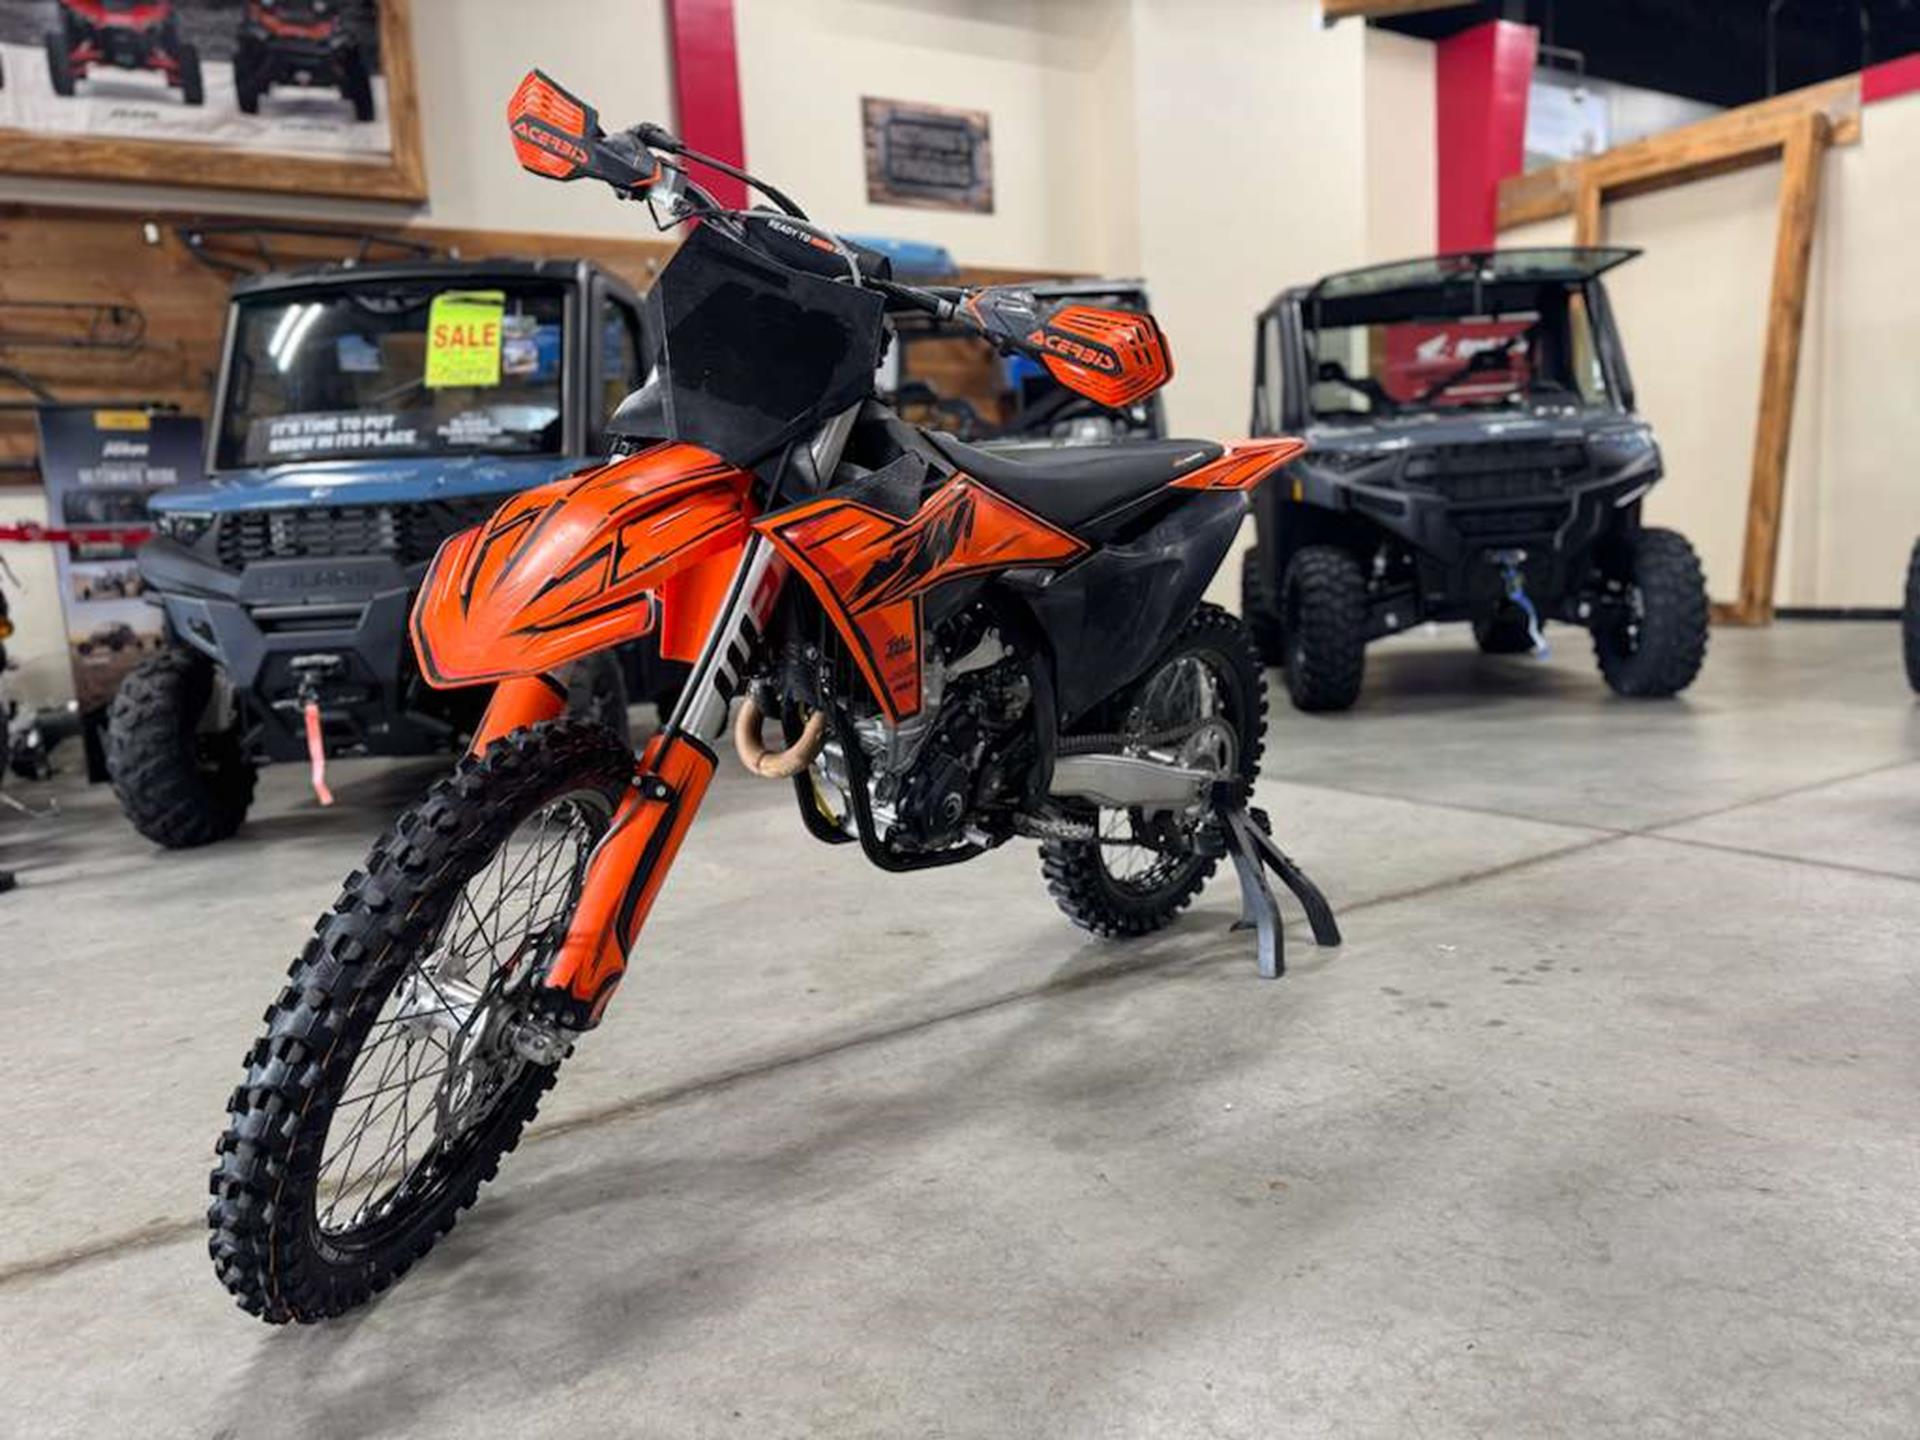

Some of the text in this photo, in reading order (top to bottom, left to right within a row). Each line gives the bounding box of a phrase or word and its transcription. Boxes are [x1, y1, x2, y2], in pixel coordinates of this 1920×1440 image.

[767, 219, 812, 243] READY TO
[433, 323, 498, 349] SALE
[1026, 329, 1115, 370] ACERBIS
[303, 417, 338, 434] TIME
[341, 416, 362, 431] TO
[363, 414, 396, 430] PUT
[336, 432, 361, 449] ITS
[363, 429, 418, 447] PLACE
